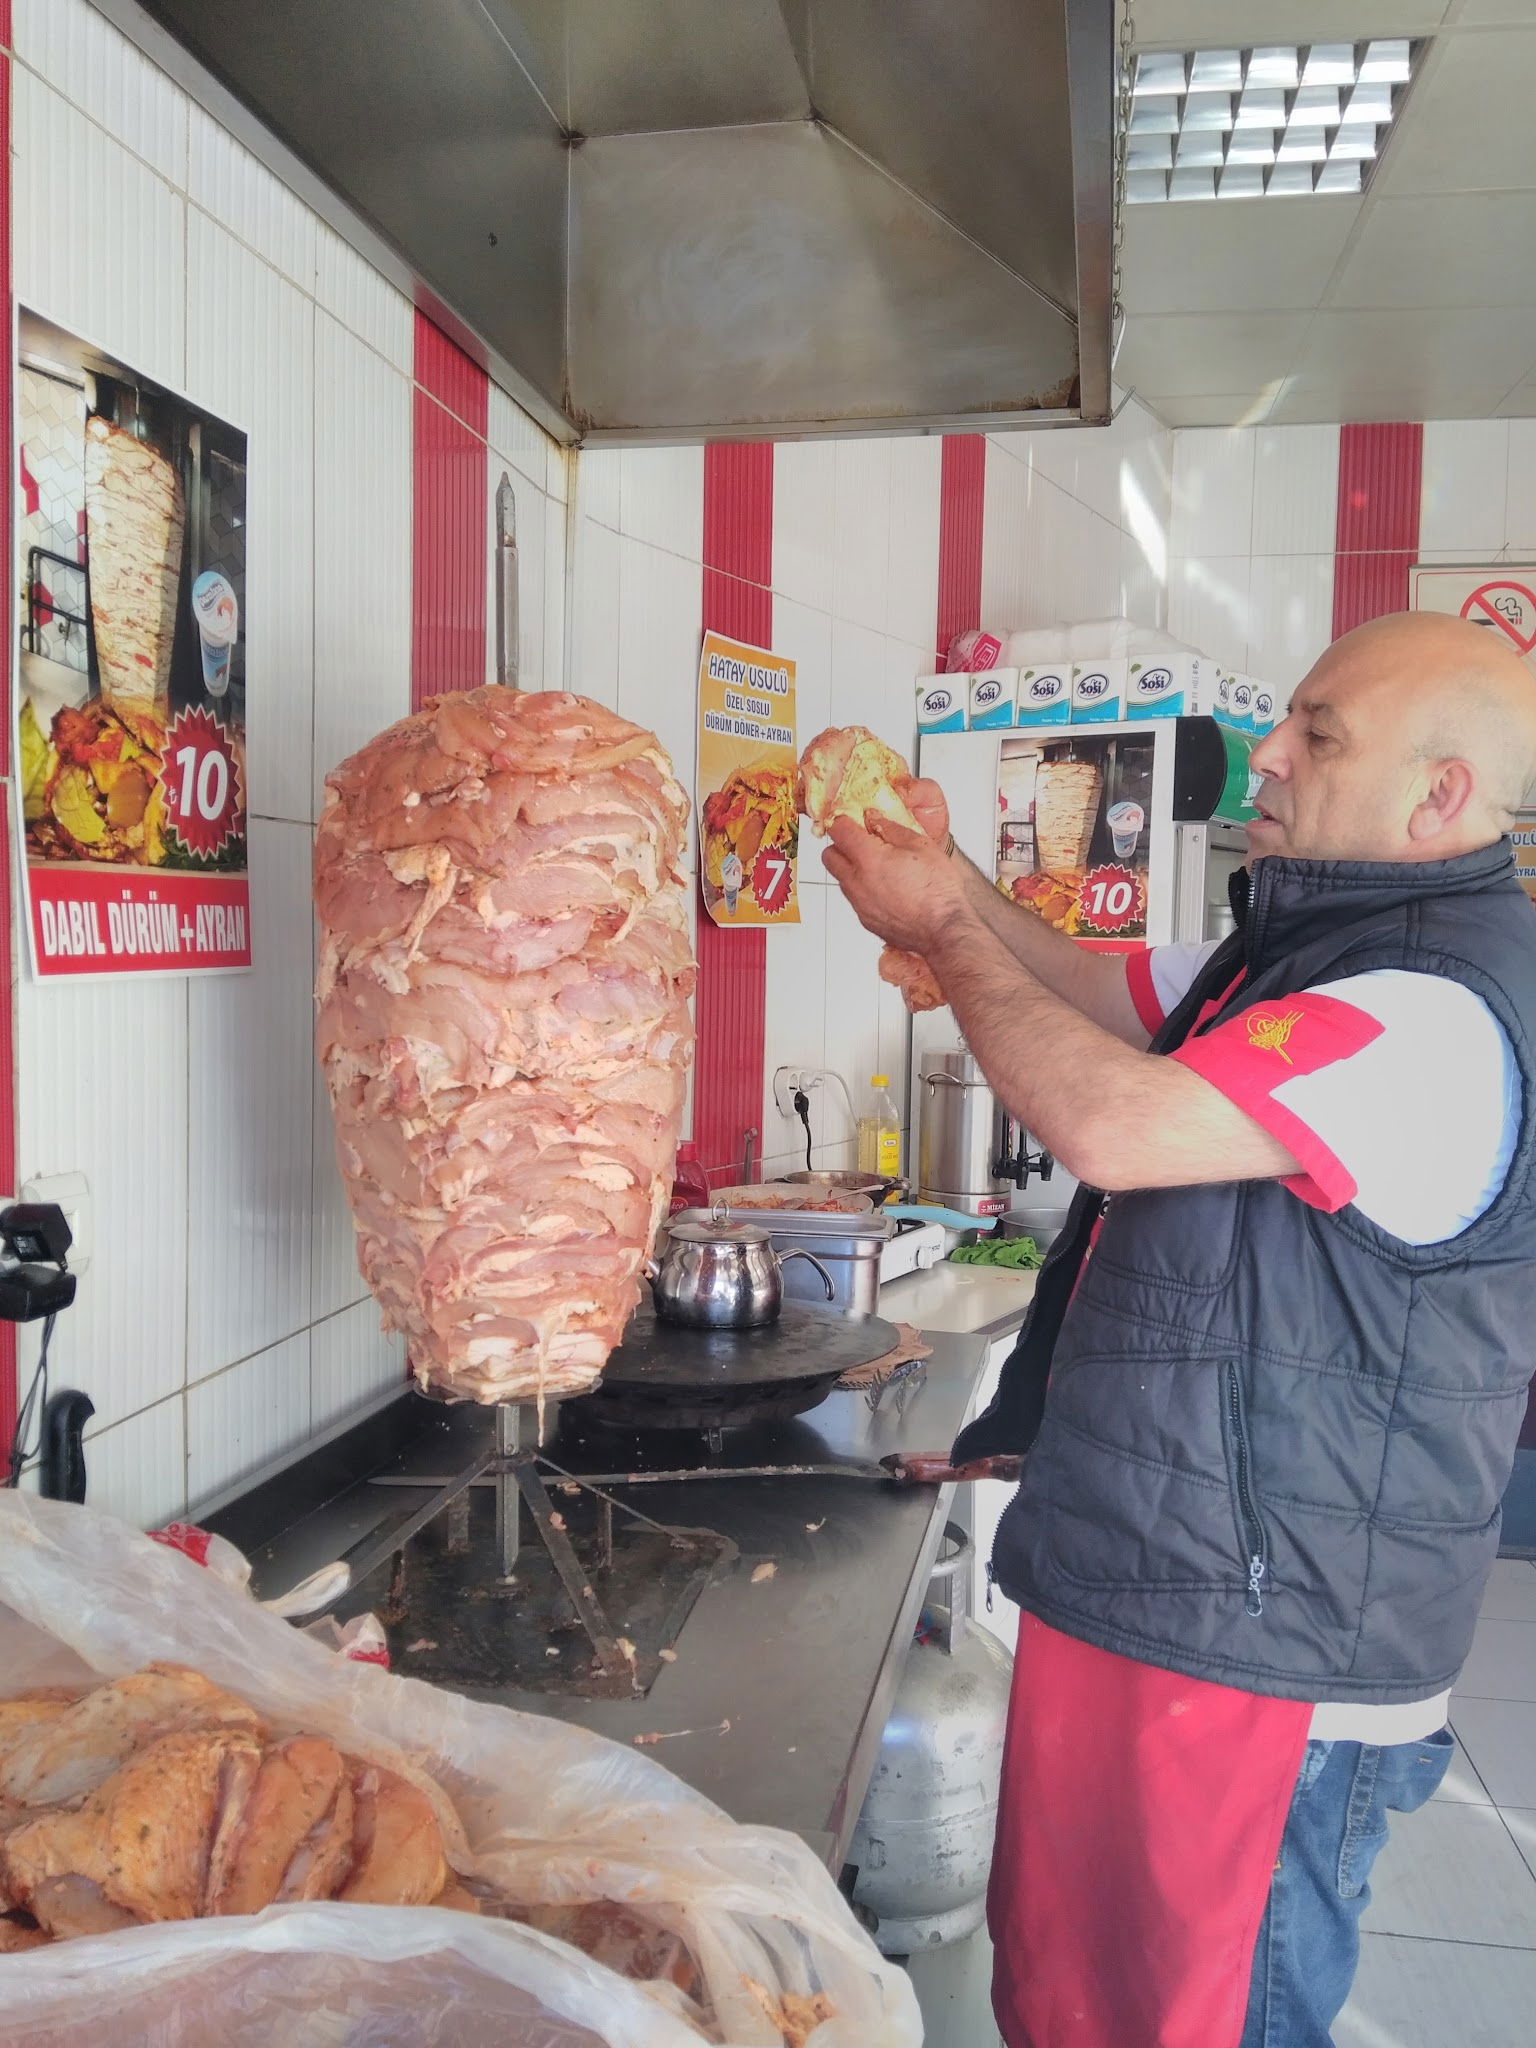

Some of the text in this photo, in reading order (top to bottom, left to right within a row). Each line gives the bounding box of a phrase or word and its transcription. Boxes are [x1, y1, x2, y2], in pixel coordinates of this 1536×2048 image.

[709, 655, 787, 694] HATAY USULÜ
[726, 691, 770, 716] ÖZEL SOSLU
[705, 712, 732, 733] DÜRÜM
[39, 900, 106, 957] DABIL
